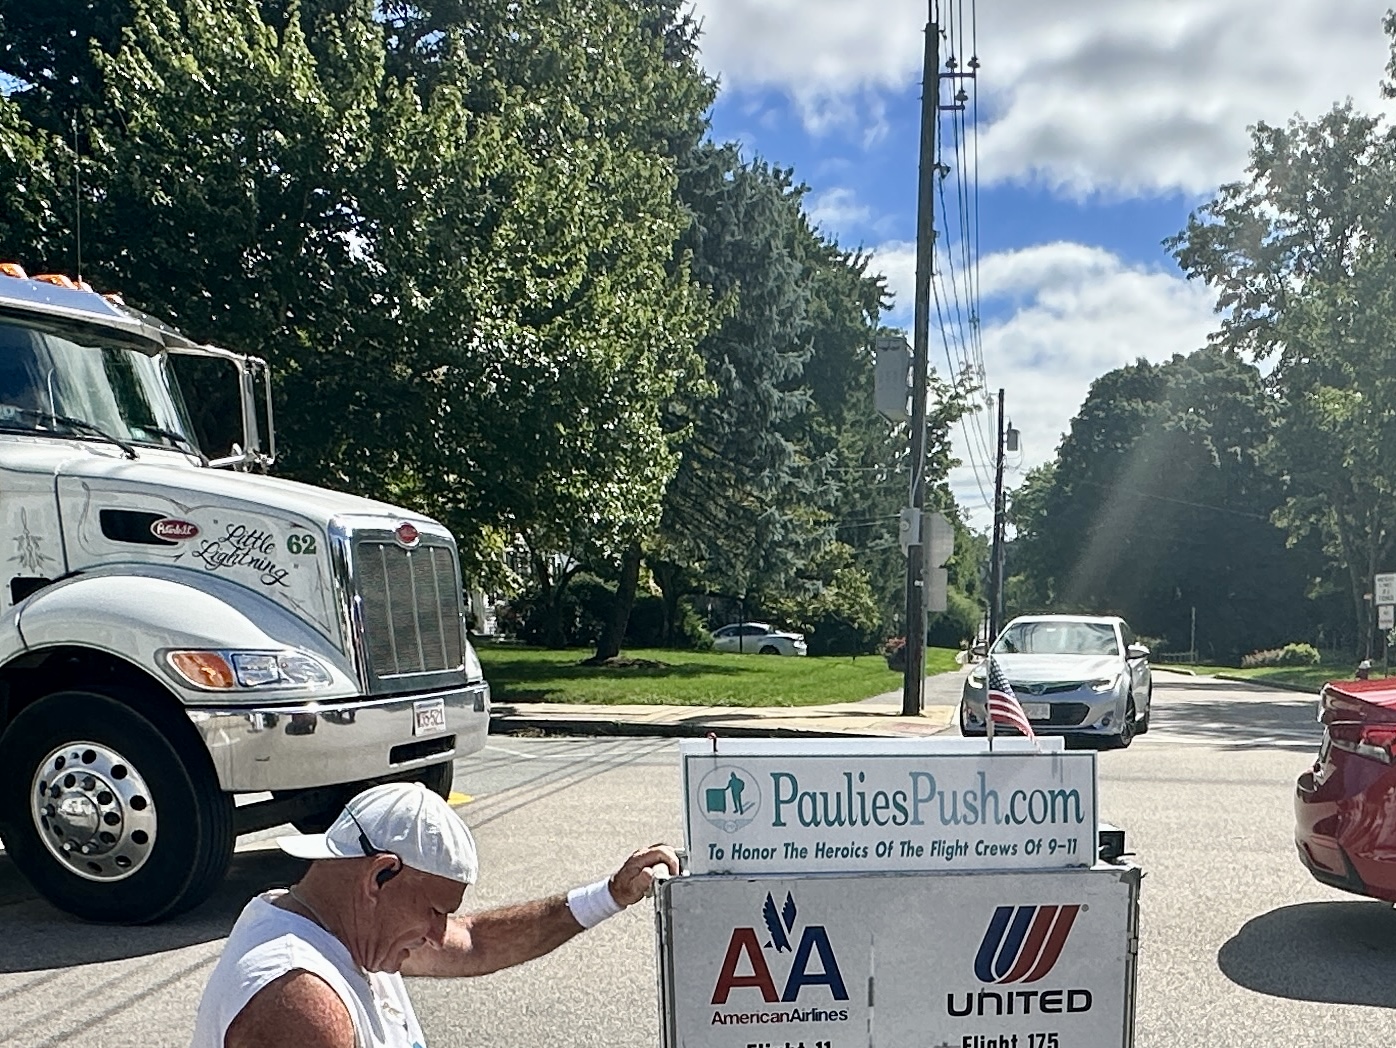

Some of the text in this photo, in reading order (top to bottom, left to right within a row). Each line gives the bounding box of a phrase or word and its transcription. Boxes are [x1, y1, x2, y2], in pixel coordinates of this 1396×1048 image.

[218, 524, 275, 555] Little
[286, 534, 317, 555] 62
[192, 539, 290, 587] Lightning
[771, 770, 1085, 828] PauliesPush.com
[708, 838, 1078, 862] To Honor The Heroics Of The Flight Crews Of 9-11
[947, 988, 1093, 1017] UNITED
